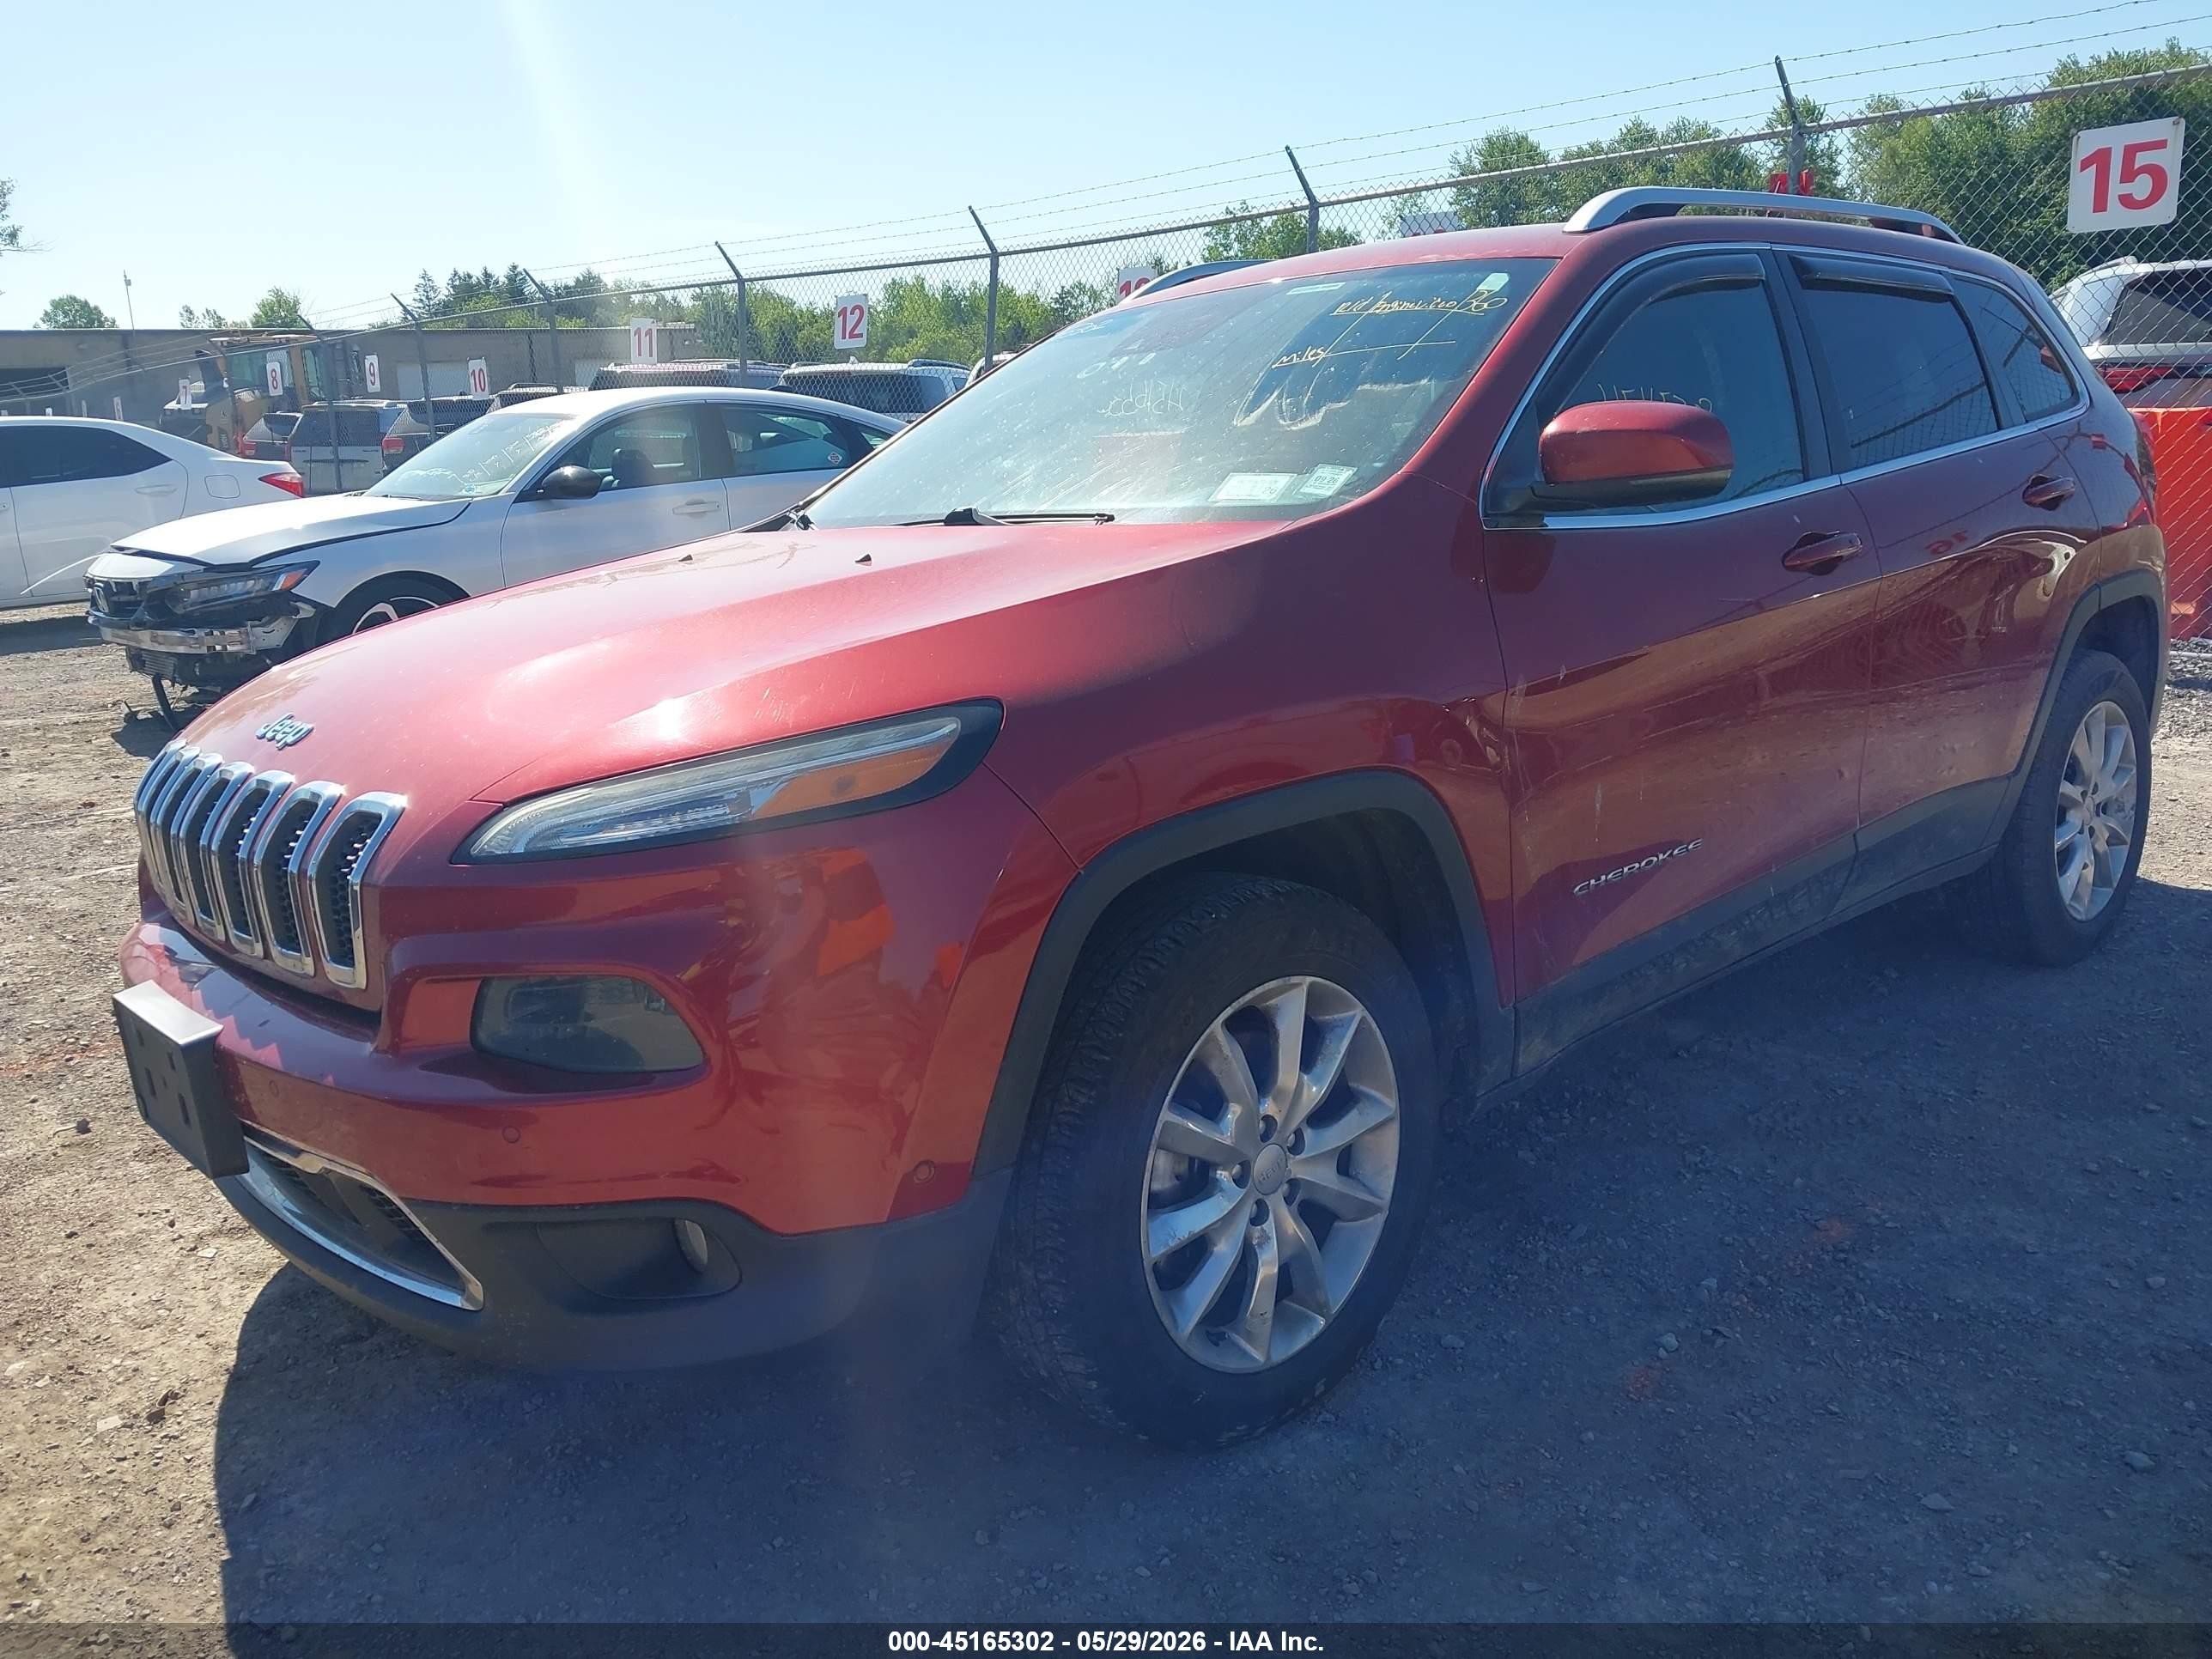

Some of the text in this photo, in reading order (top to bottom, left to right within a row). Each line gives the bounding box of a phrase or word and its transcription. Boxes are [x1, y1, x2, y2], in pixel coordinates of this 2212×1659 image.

[2079, 138, 2169, 214] 15
[837, 304, 865, 340] 12
[633, 327, 653, 358] 11
[270, 368, 278, 390] 8
[368, 362, 376, 386] 9
[471, 368, 486, 392] 10
[255, 712, 315, 751] Jeep
[1573, 837, 1704, 896] CHEROKEE
